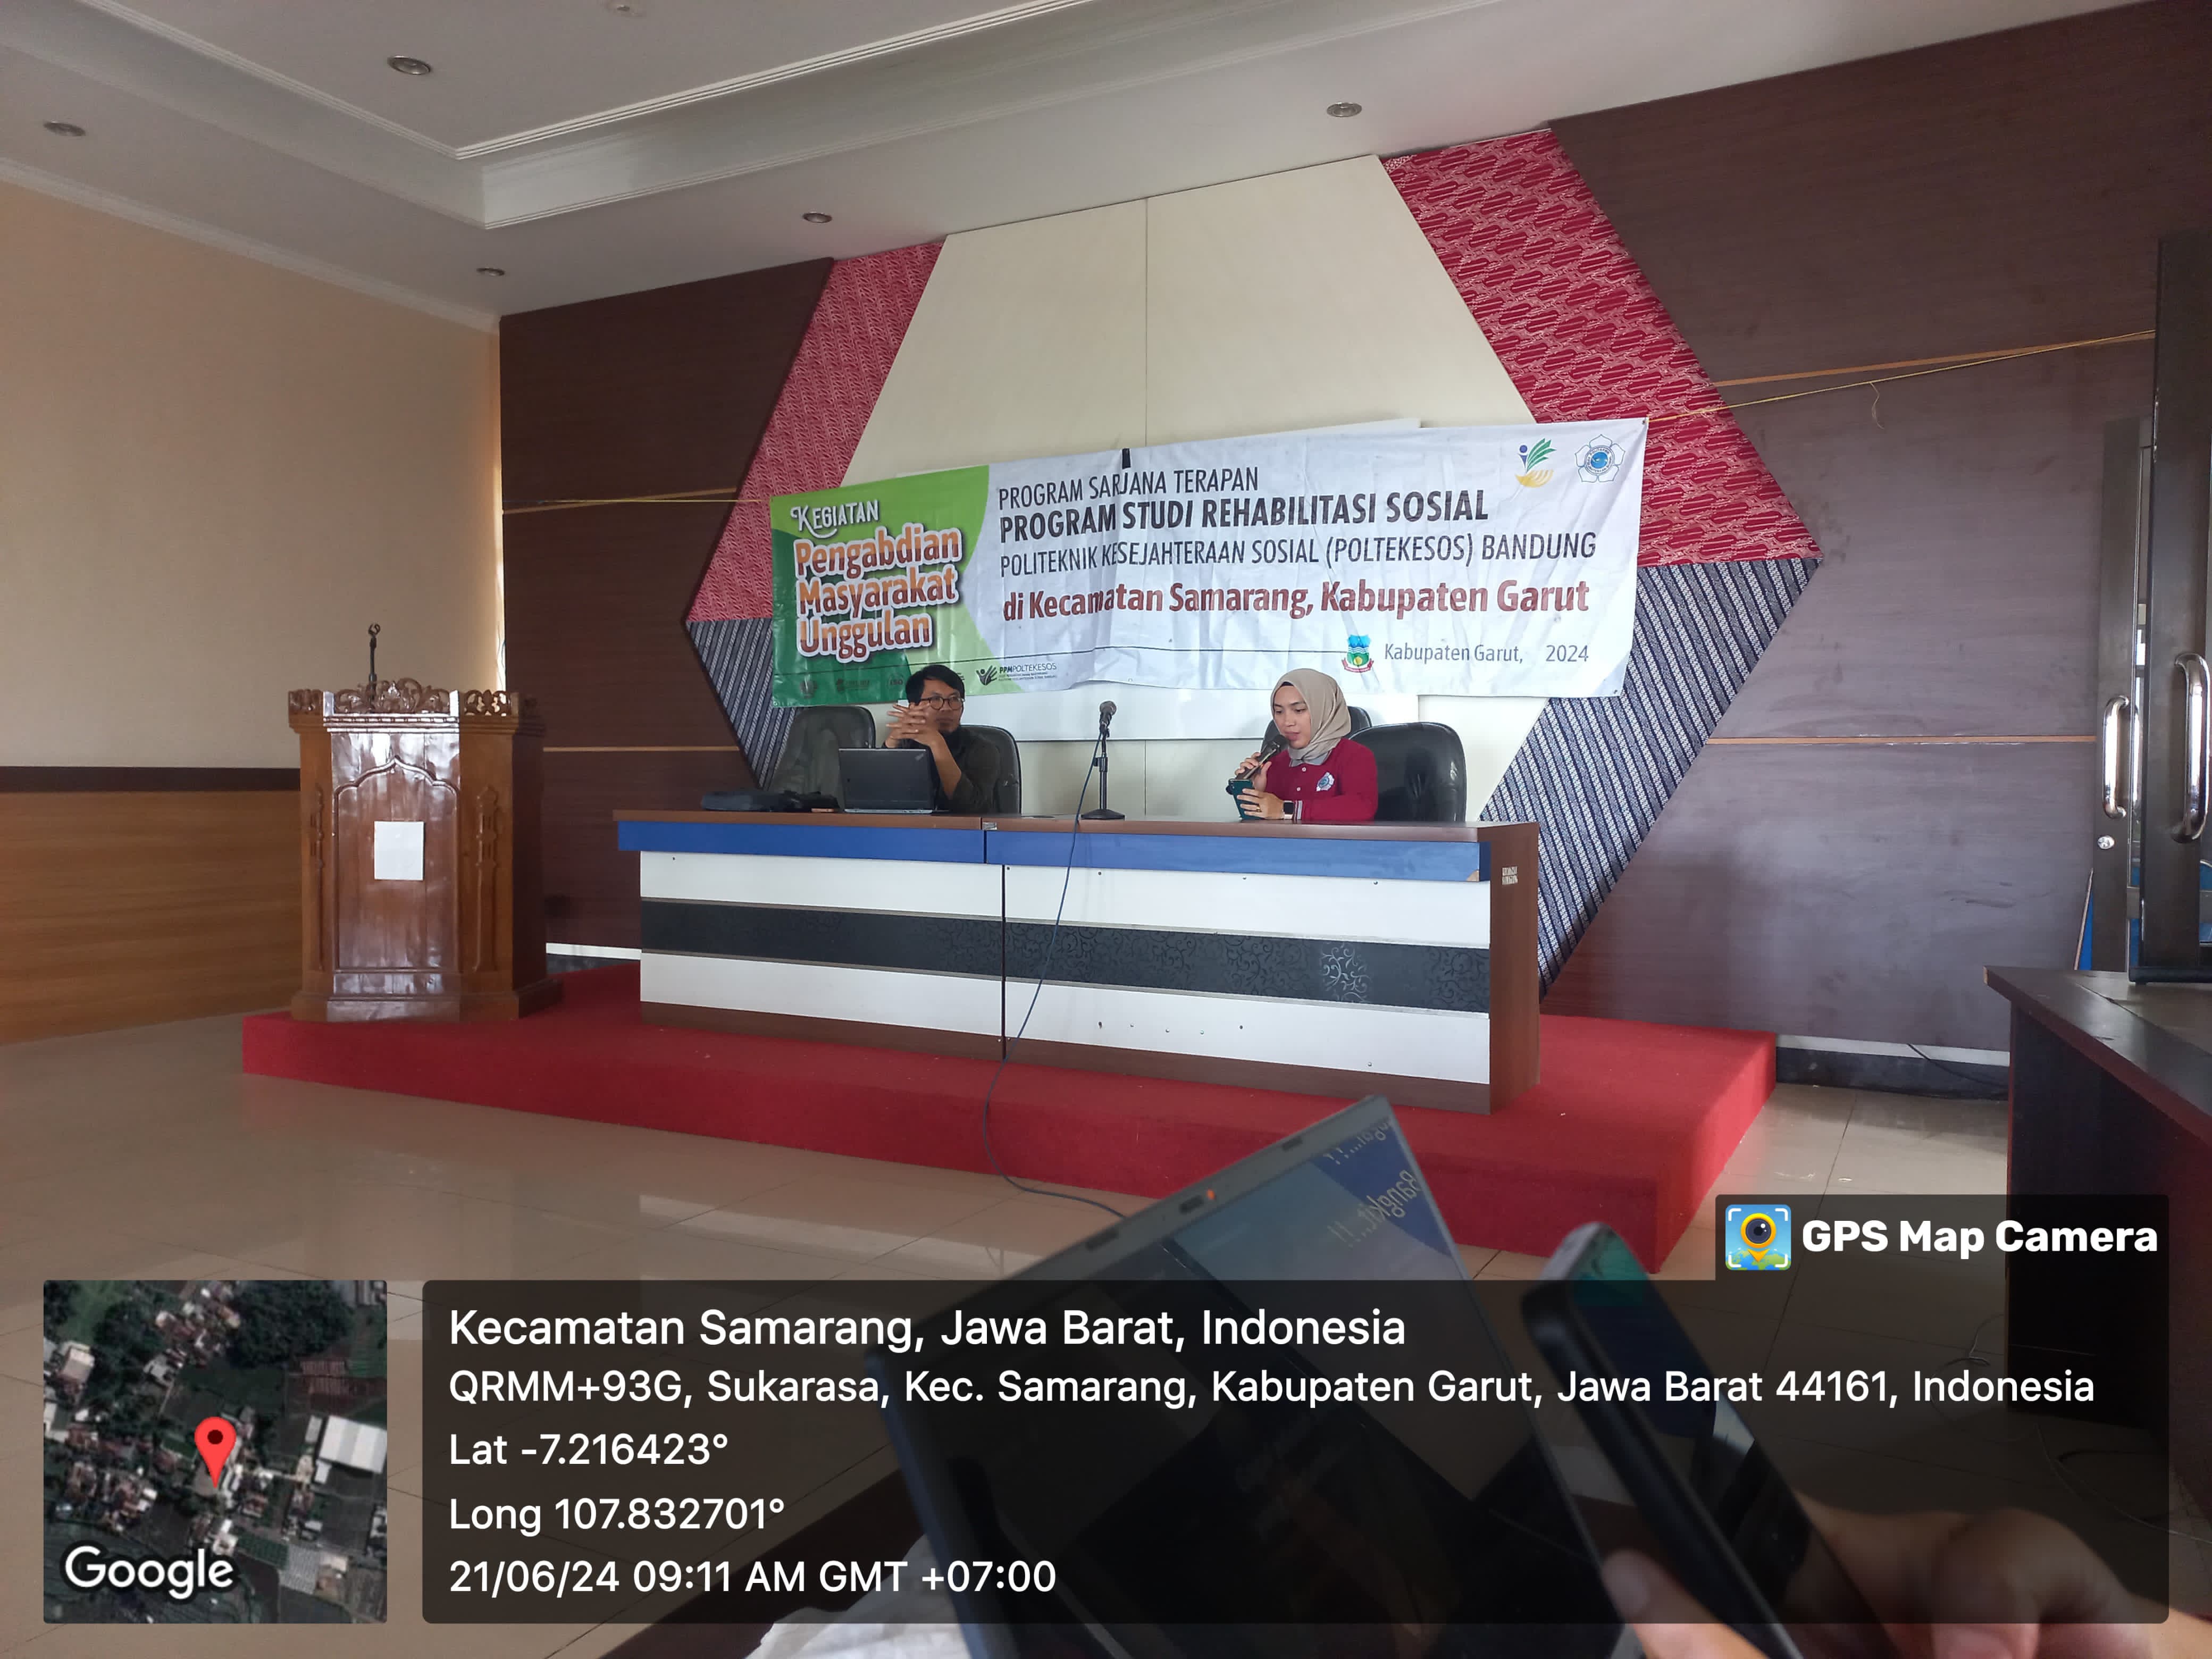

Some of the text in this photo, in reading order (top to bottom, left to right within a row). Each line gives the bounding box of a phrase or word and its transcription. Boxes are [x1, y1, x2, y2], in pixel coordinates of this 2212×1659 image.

[999, 467, 1258, 510] PROGRAM SARJANA TERAPAN
[791, 500, 878, 538] KEGIATAN
[1000, 490, 1488, 543] PROGRAM STUDI REHABILITASI SOSIAL
[794, 524, 960, 580] Pengabdian
[1001, 532, 1596, 577] POLITEKNIK KESEJAHTERAAN SOSIAL (POLTEKESOS) BANDUNG
[797, 565, 958, 618] Masyarakat
[1003, 579, 1589, 621] di Kecamatan Samarang, Kabupaten Garut
[799, 610, 931, 659] Unggulan
[1385, 642, 1589, 664] Kabupaten Garut, 2024
